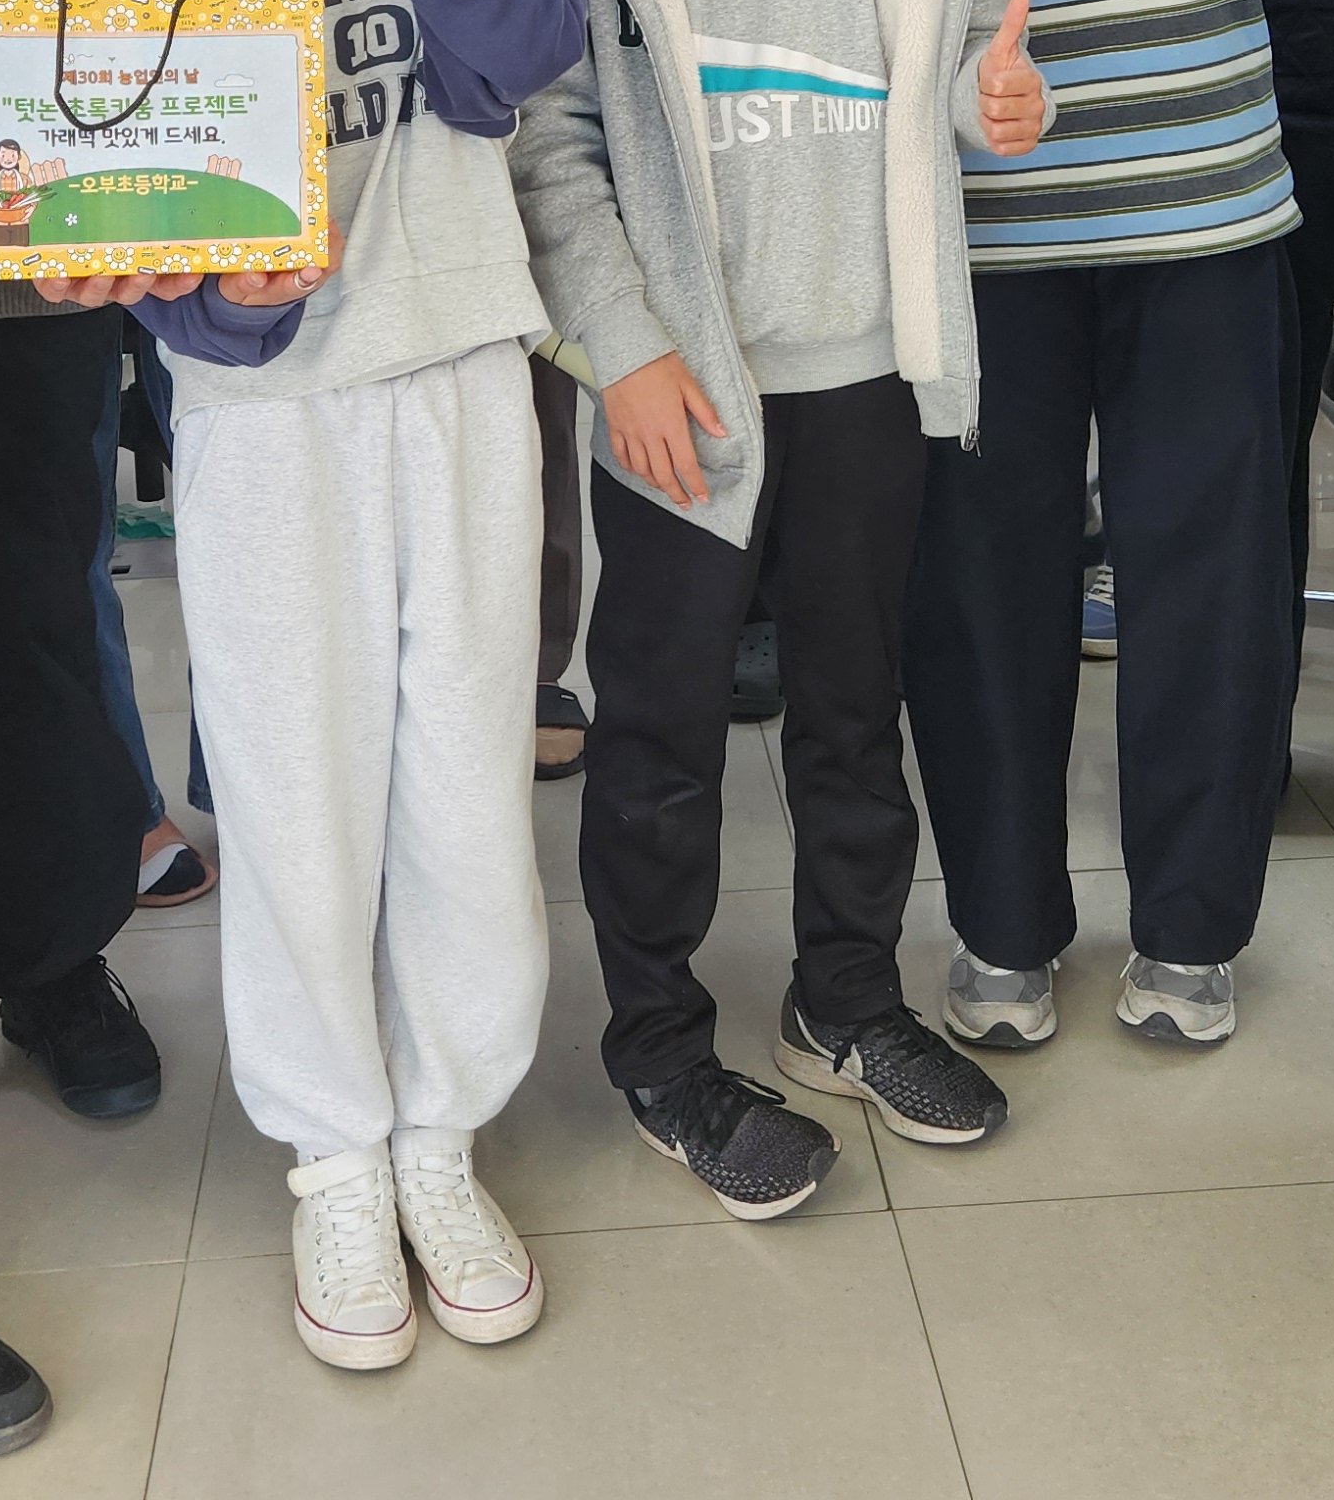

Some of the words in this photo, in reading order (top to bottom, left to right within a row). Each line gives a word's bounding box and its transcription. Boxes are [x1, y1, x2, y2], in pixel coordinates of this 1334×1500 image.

[347, 11, 401, 68] 10
[184, 68, 199, 84] 날
[160, 93, 258, 119] 프로젝트"
[812, 94, 882, 135] ENJOY
[38, 128, 95, 149] 가래떡
[102, 126, 158, 149] 맛있게
[164, 125, 225, 146] 드세요.
